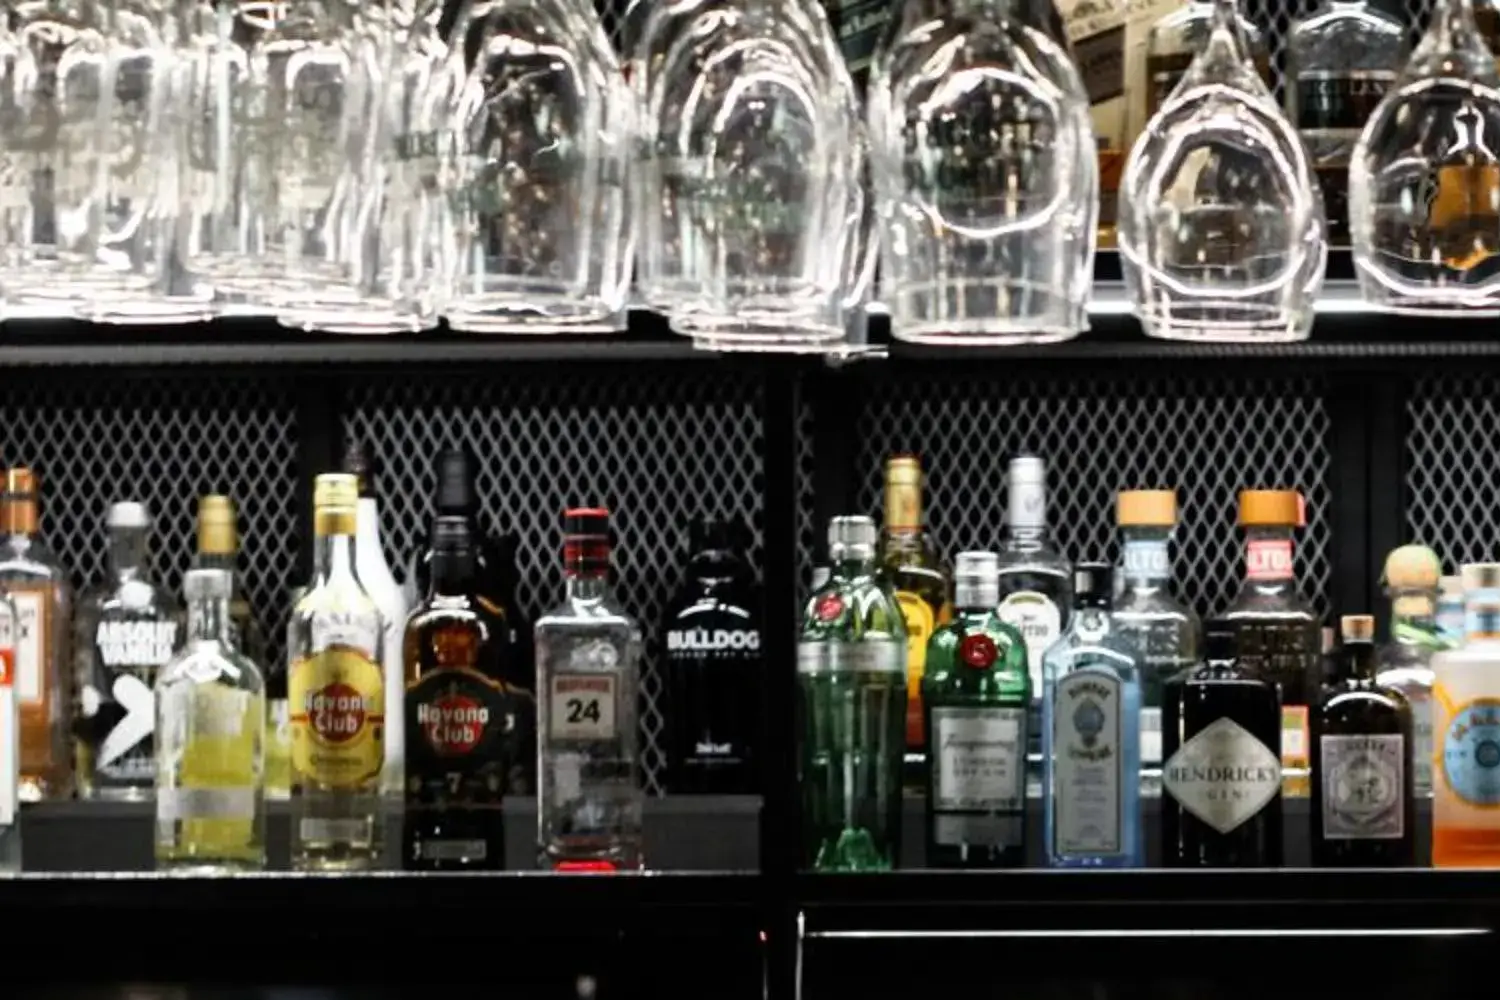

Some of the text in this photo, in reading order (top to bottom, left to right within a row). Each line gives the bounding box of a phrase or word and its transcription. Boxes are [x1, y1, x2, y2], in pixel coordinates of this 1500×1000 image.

[97, 620, 178, 645] ABSOLUT
[667, 627, 760, 650] BULLDOG
[315, 711, 359, 733] Club
[417, 702, 489, 725] Havana
[566, 699, 600, 724] 24
[430, 723, 476, 743] Club
[446, 772, 462, 794] 7
[1207, 786, 1244, 801] GIN
